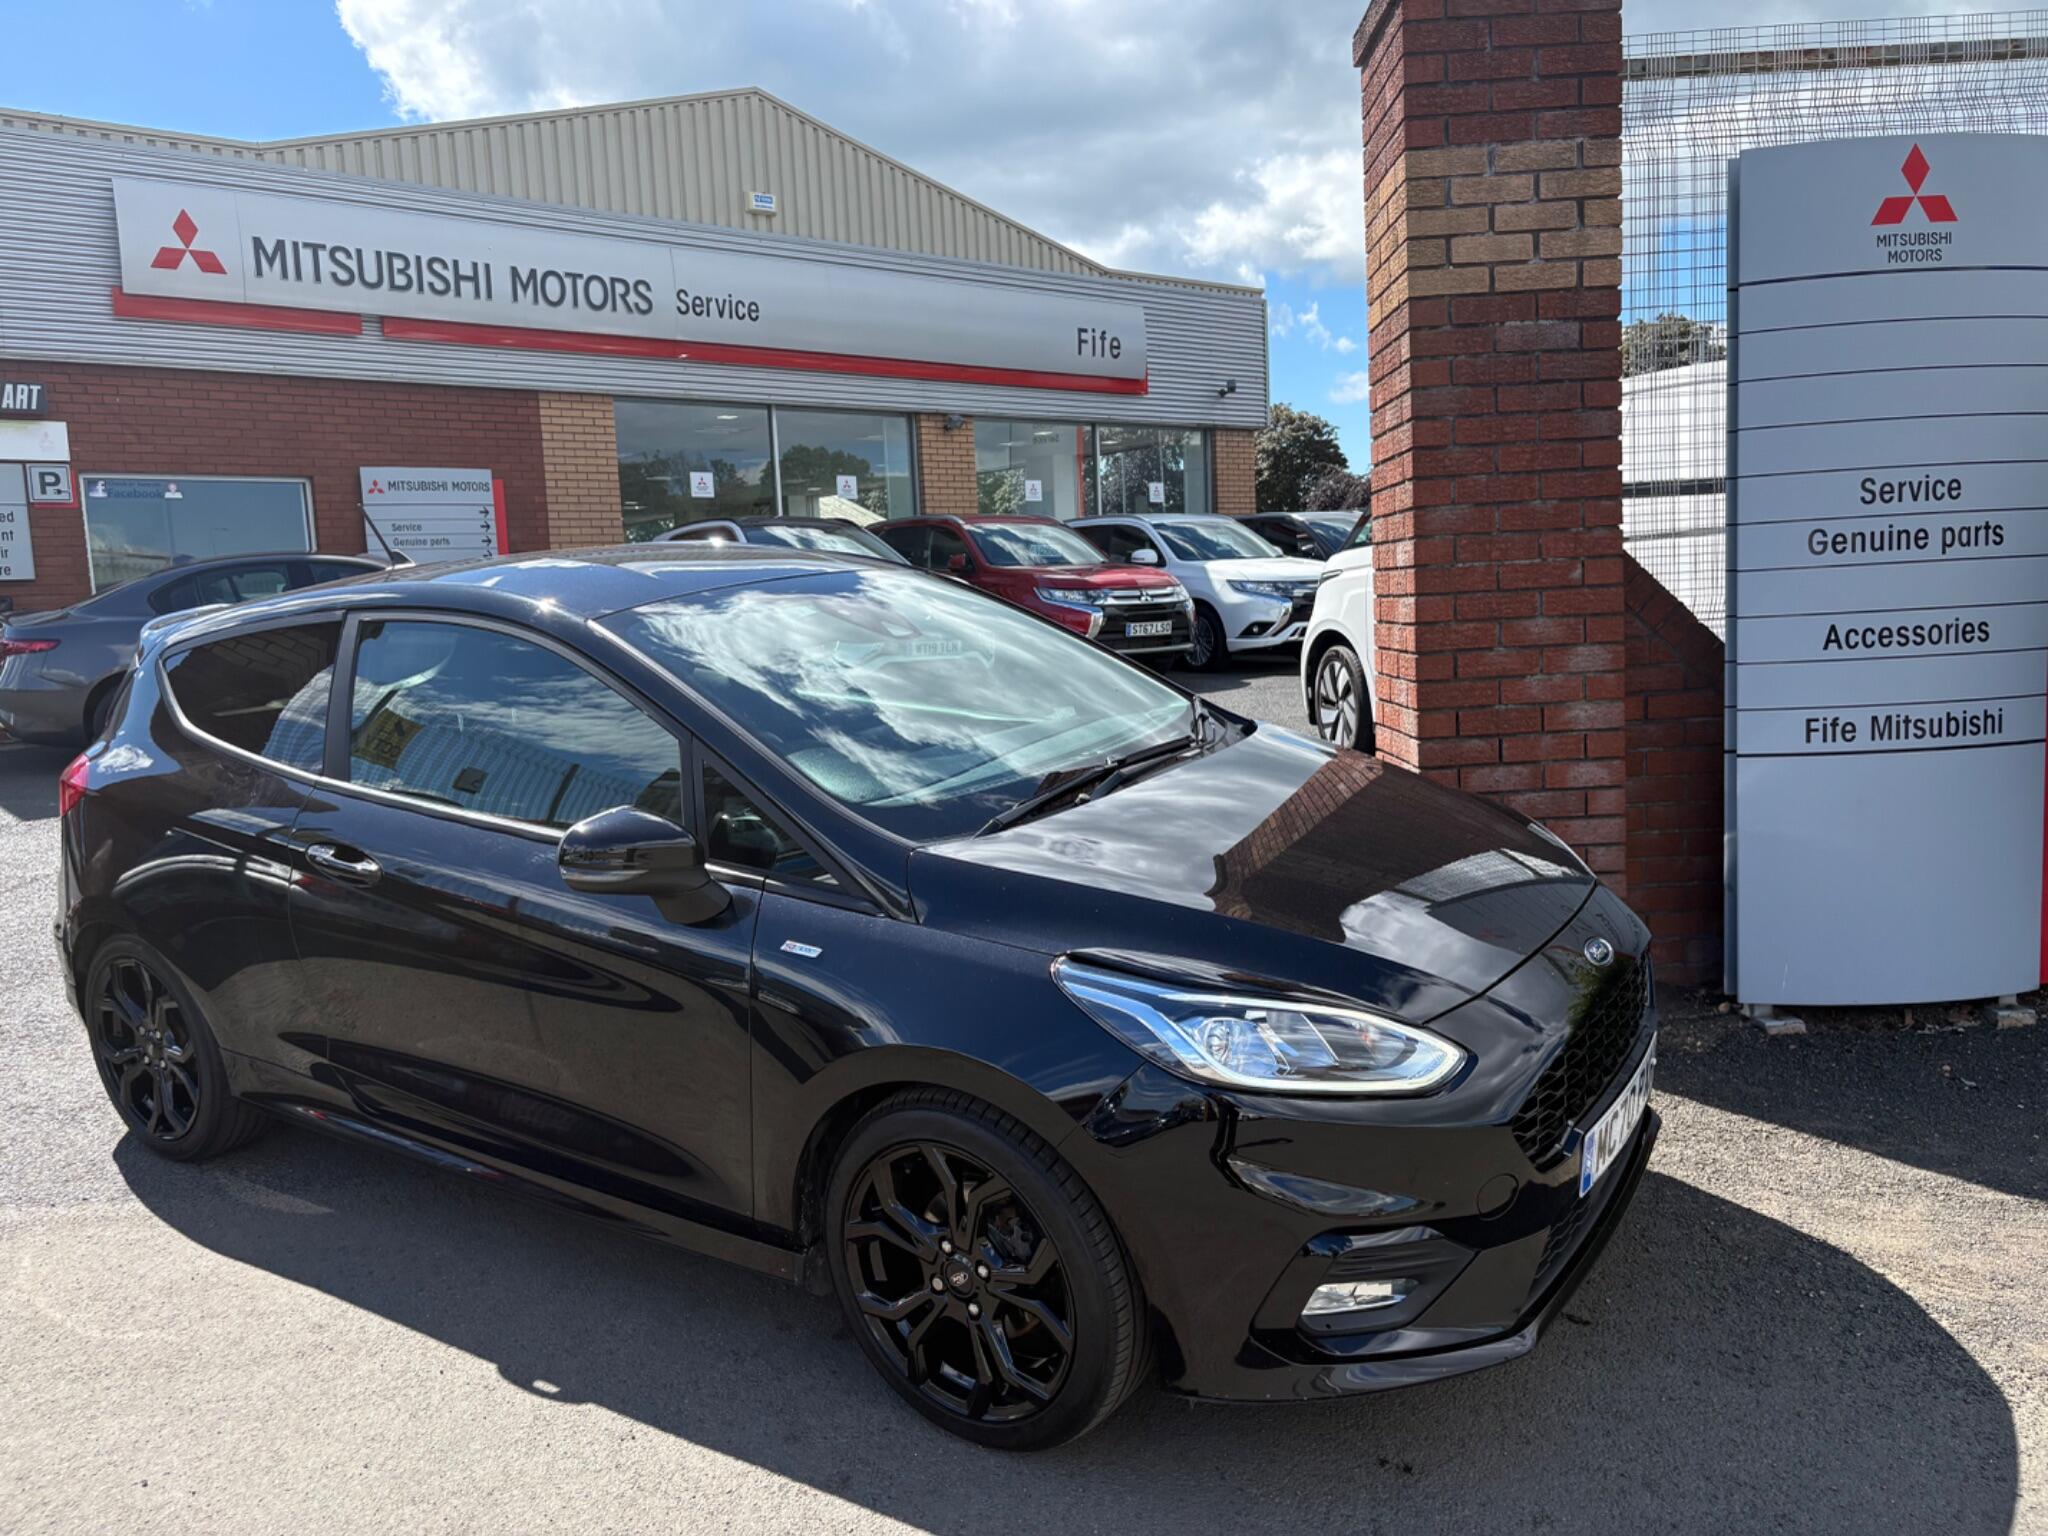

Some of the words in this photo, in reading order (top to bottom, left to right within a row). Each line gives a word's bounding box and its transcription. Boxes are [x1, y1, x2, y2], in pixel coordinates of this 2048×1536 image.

[1876, 231, 1952, 248] MITSUBISHI
[1888, 248, 1943, 263] MOTORS
[251, 235, 493, 301] MITSUBISHI
[510, 265, 654, 316] MOTORS
[676, 288, 760, 322] Service
[1077, 327, 1121, 360] Fife
[38, 471, 61, 496] P
[387, 480, 448, 492] MITSUBISHI
[452, 481, 491, 493] MOTORS
[1859, 474, 1963, 505] Service
[391, 523, 422, 533] Service
[1808, 524, 1930, 556] Genuine
[1941, 520, 2005, 556] parts
[393, 538, 428, 547] Genuine
[1133, 623, 1154, 635] ST67
[1822, 617, 1991, 651] Accessories
[1805, 717, 1857, 744] Fife
[1871, 707, 2004, 742] Mitsubishi
